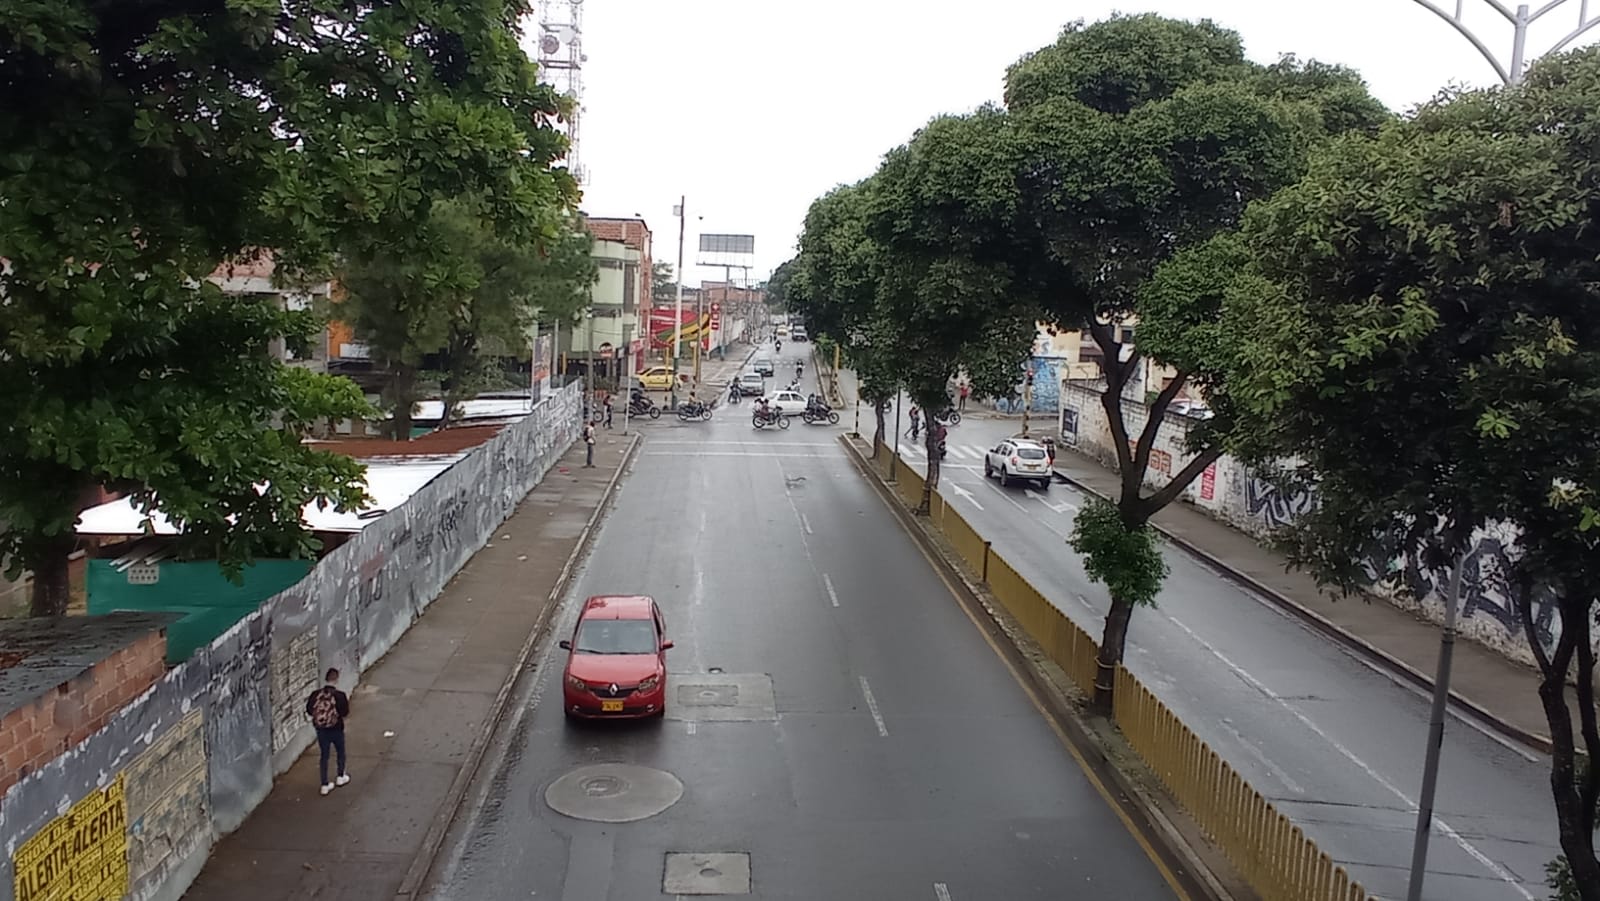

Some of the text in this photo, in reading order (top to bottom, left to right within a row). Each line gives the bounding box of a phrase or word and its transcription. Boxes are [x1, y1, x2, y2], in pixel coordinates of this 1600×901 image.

[72, 799, 124, 859] ALERTA
[73, 794, 104, 823] SHOW
[109, 782, 123, 798] DE
[17, 834, 50, 869] SHOW
[54, 822, 69, 838] DE
[19, 841, 69, 901] ALERTA
